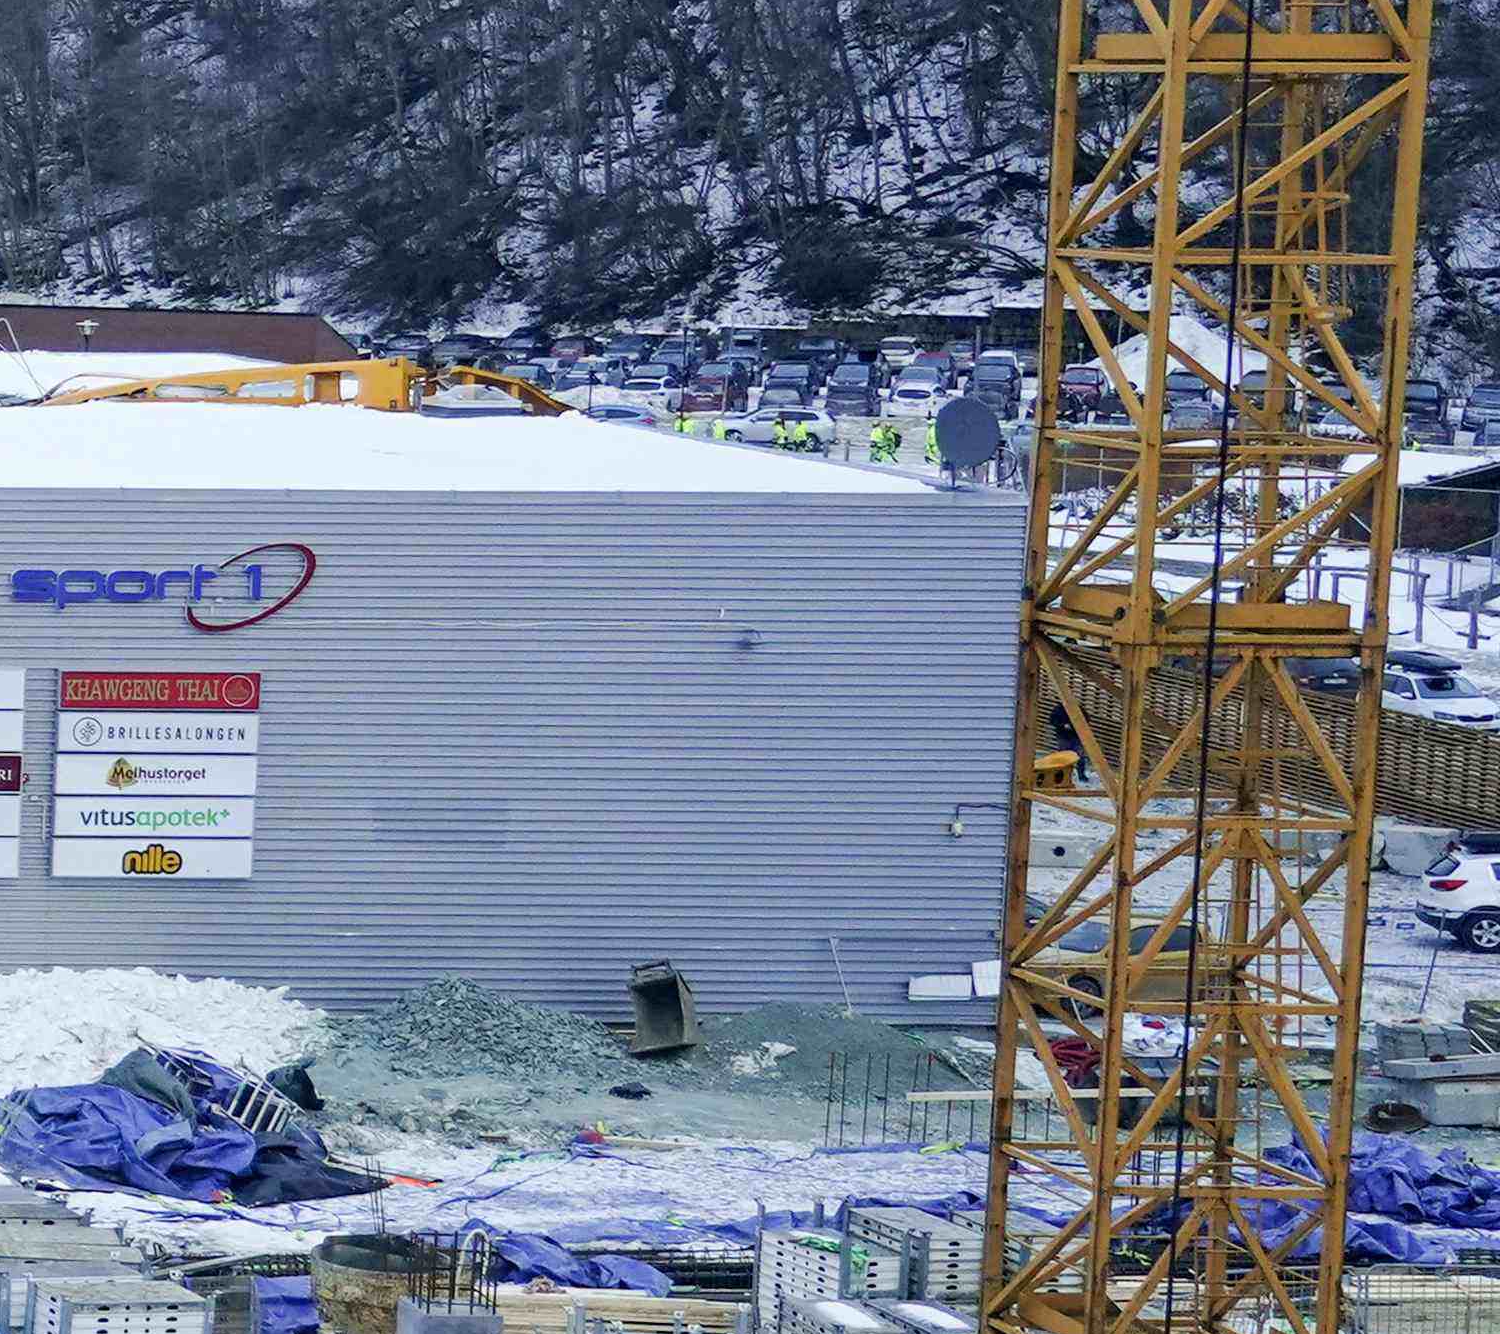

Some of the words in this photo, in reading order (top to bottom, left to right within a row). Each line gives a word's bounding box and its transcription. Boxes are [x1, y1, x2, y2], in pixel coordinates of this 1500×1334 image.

[10, 563, 221, 609] sport
[64, 678, 170, 701] KHAWGENG
[176, 680, 221, 701] THAI
[107, 726, 246, 741] BRILLESALONGEN
[111, 765, 206, 782] Melhustorget
[122, 844, 183, 874] nille
